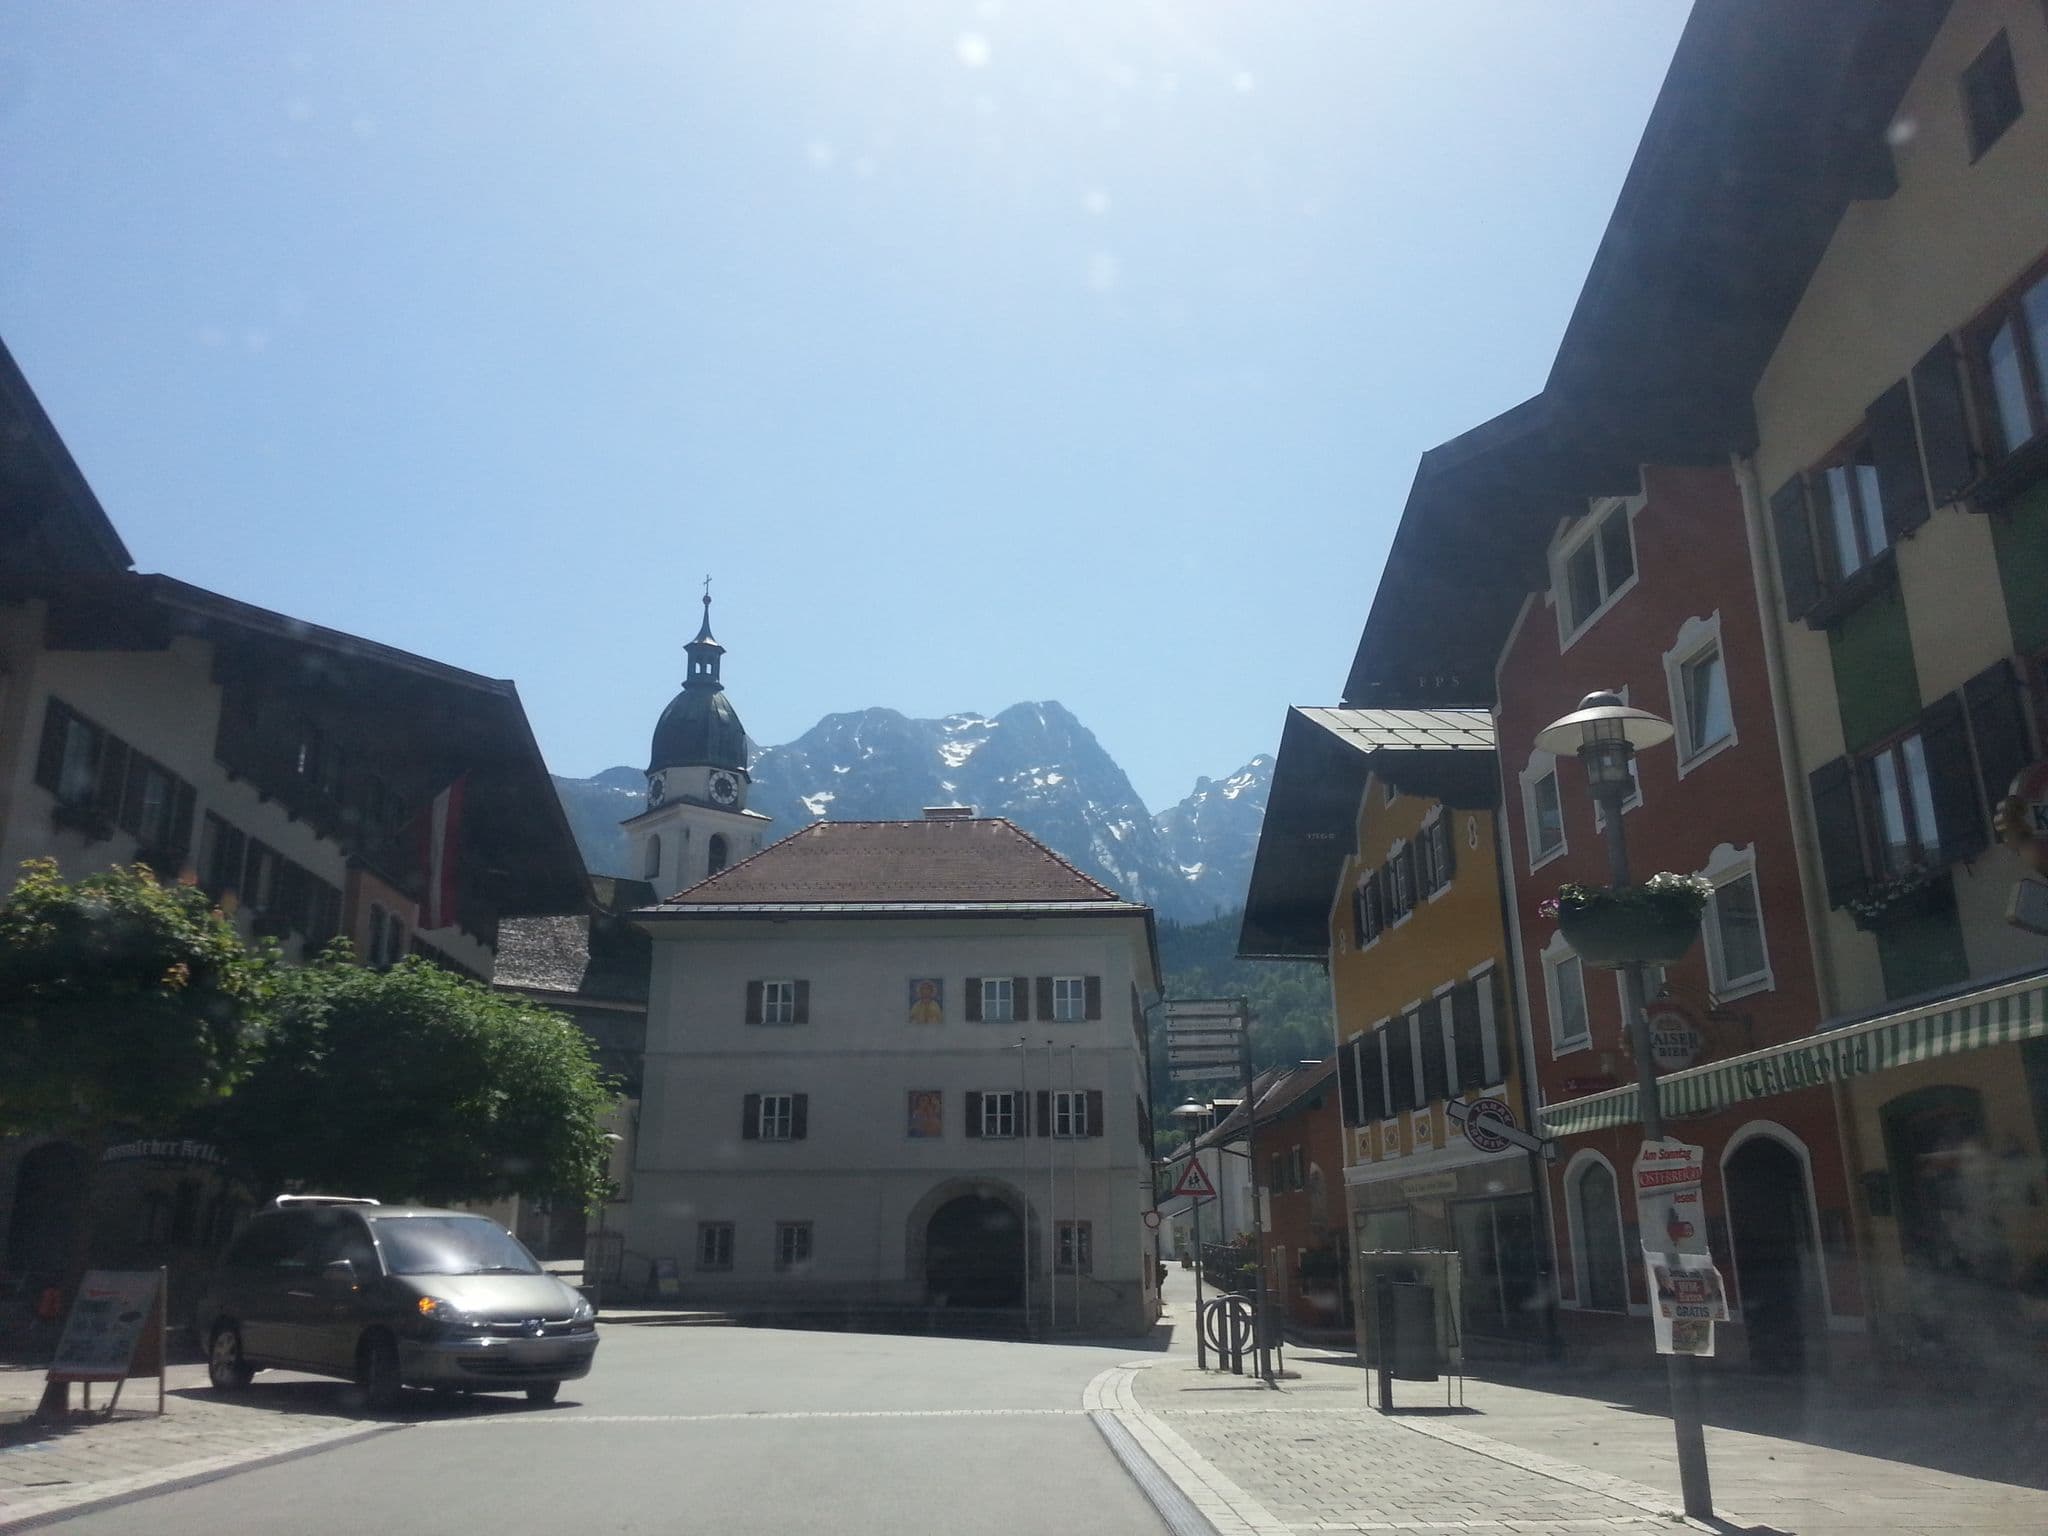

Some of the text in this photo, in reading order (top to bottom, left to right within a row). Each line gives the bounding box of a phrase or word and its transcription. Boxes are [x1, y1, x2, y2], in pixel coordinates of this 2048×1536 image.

[1659, 1047, 1689, 1057] BIER
[1475, 1102, 1514, 1125] TABAK
[1468, 1120, 1507, 1148] TRAFIK
[1642, 1148, 1692, 1161] Am Sonntag
[1675, 1305, 1710, 1318] GRATIS
